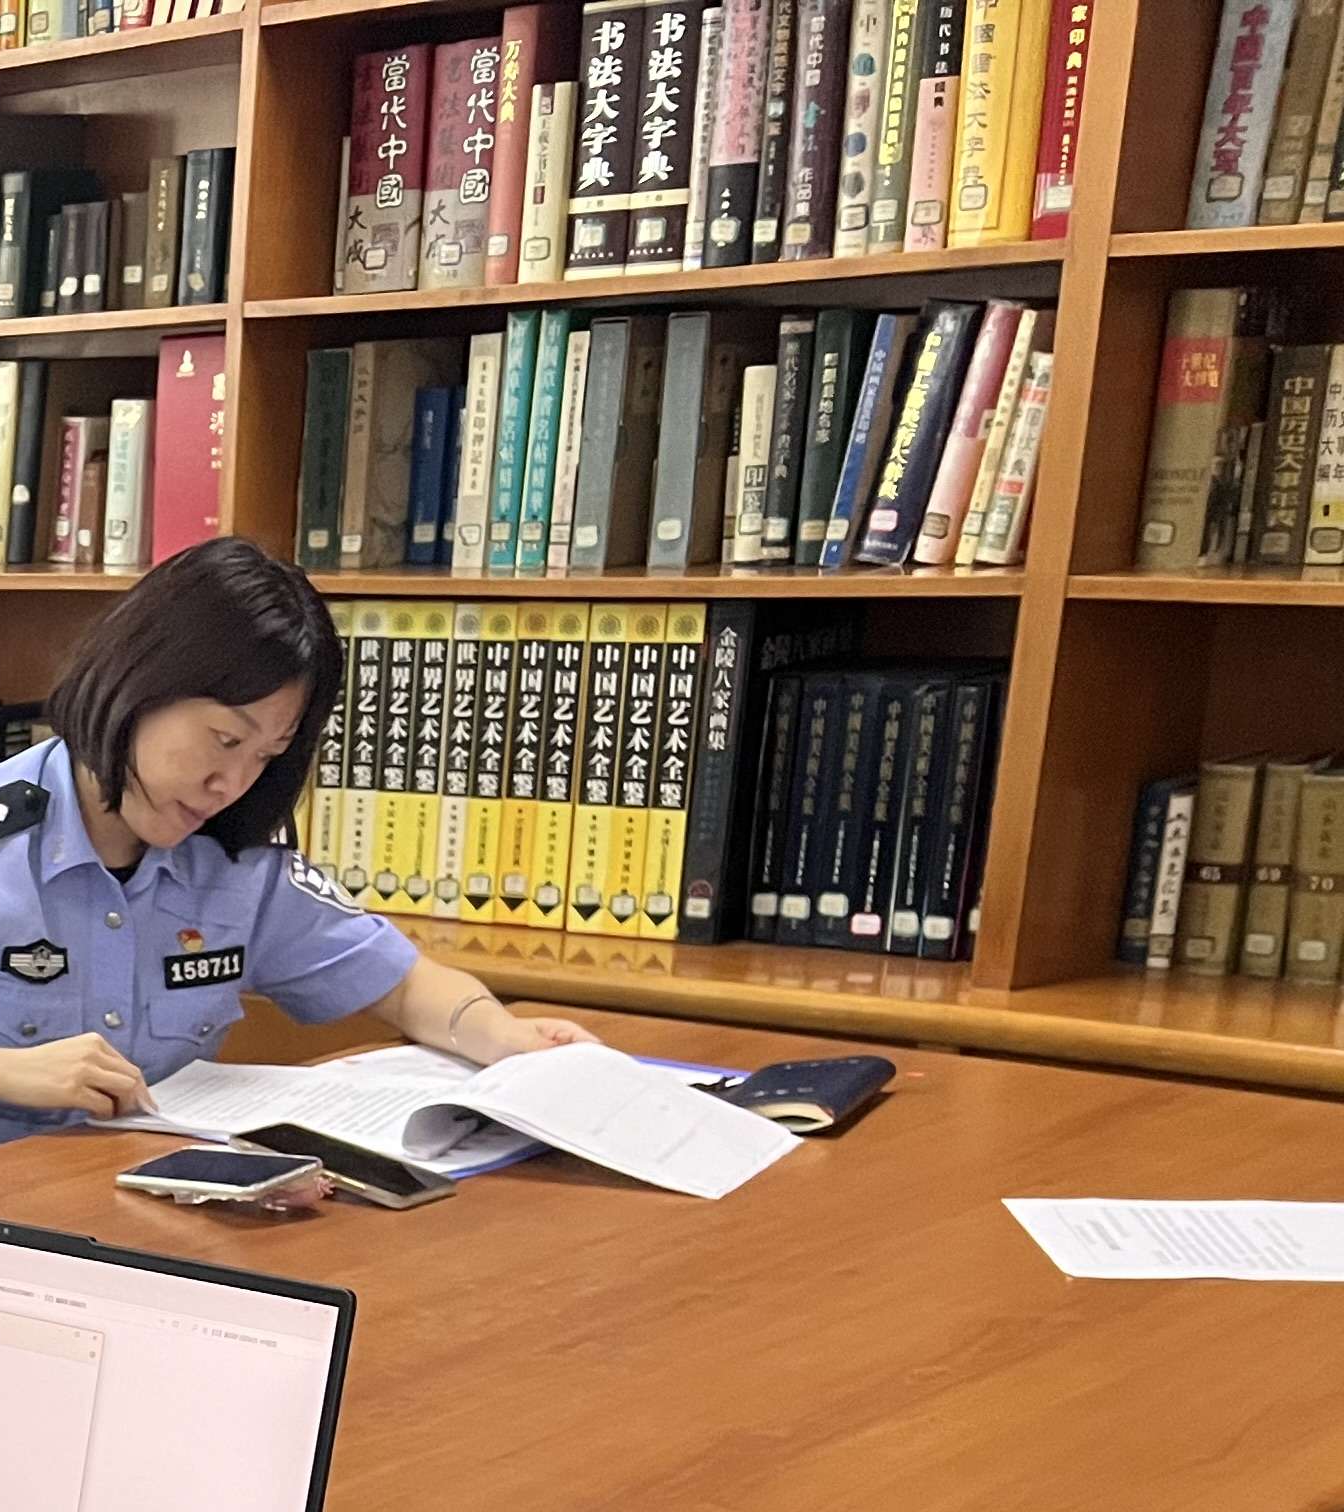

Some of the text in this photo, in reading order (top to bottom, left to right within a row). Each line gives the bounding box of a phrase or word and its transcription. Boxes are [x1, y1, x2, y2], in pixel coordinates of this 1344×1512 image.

[376, 54, 410, 208] 當代中國
[460, 46, 500, 204] 當代中國
[578, 20, 625, 191] 书法大字典
[639, 12, 686, 184] 书法大字典
[171, 953, 241, 982] 158711
